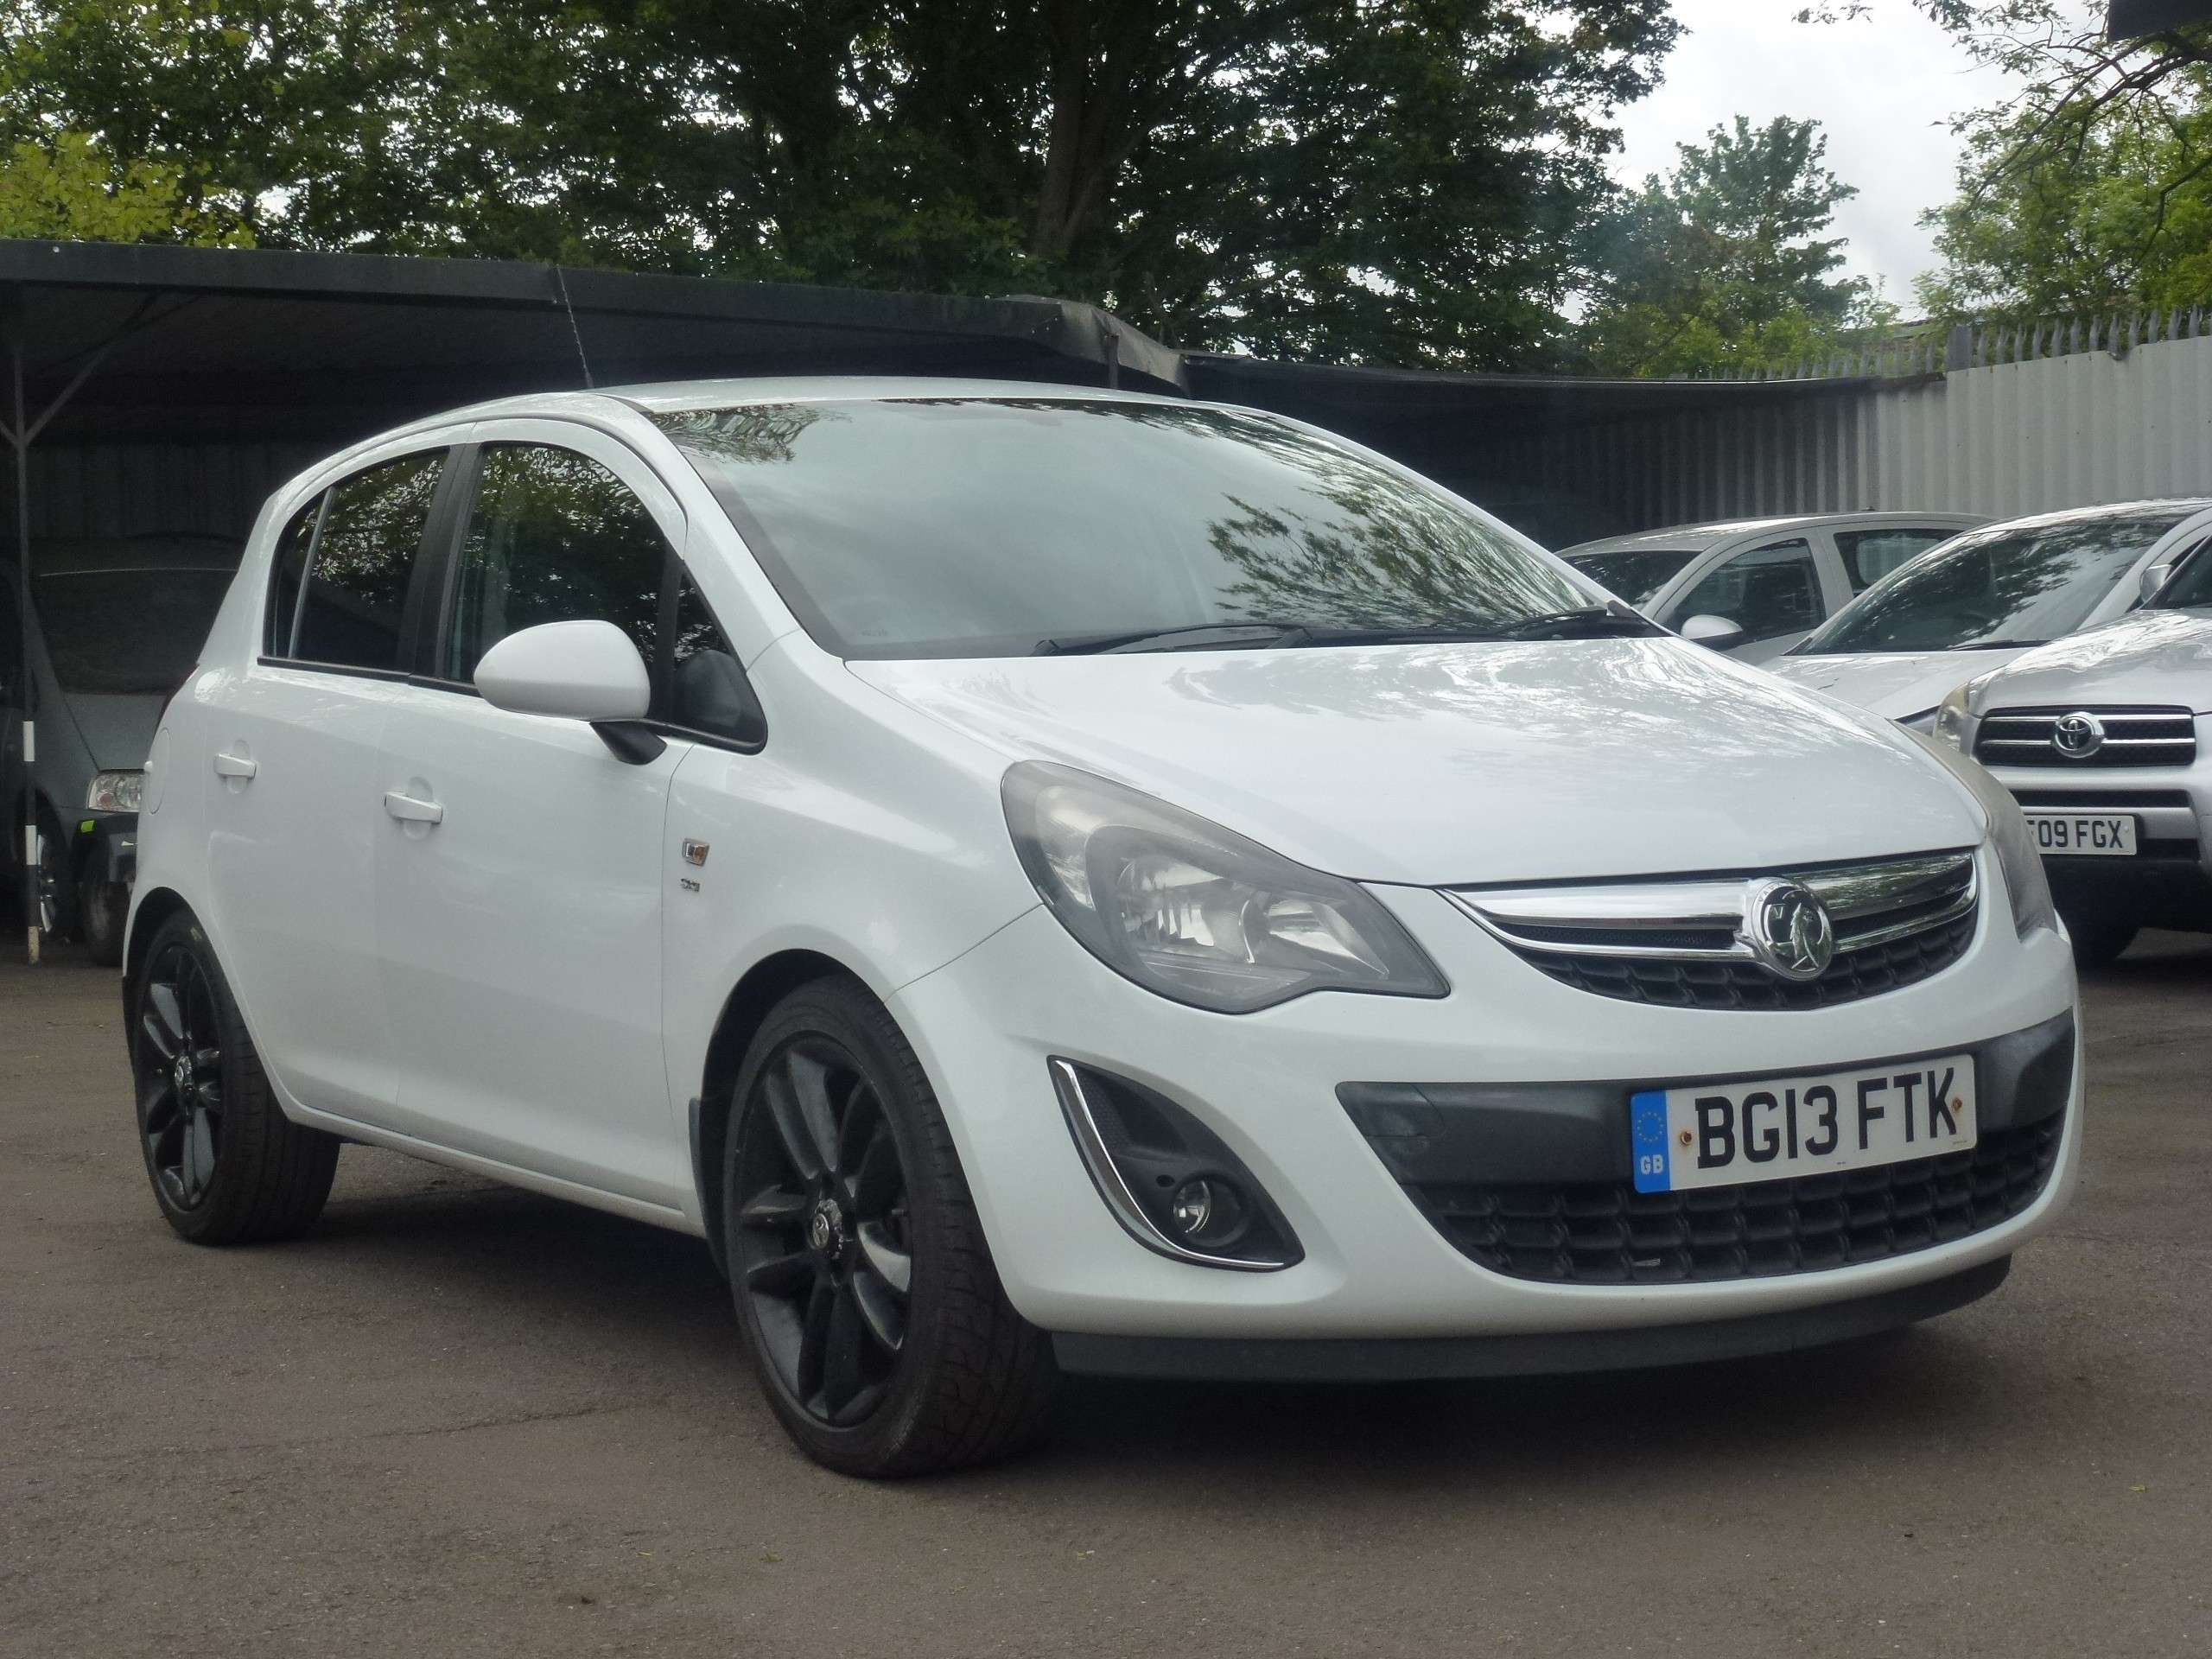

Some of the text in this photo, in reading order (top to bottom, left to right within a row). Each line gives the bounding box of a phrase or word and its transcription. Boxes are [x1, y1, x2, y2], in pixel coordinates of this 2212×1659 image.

[2075, 820, 2123, 848] FGX
[1694, 1067, 1957, 1169] BG13 FTK
[1641, 1154, 1663, 1174] GB
